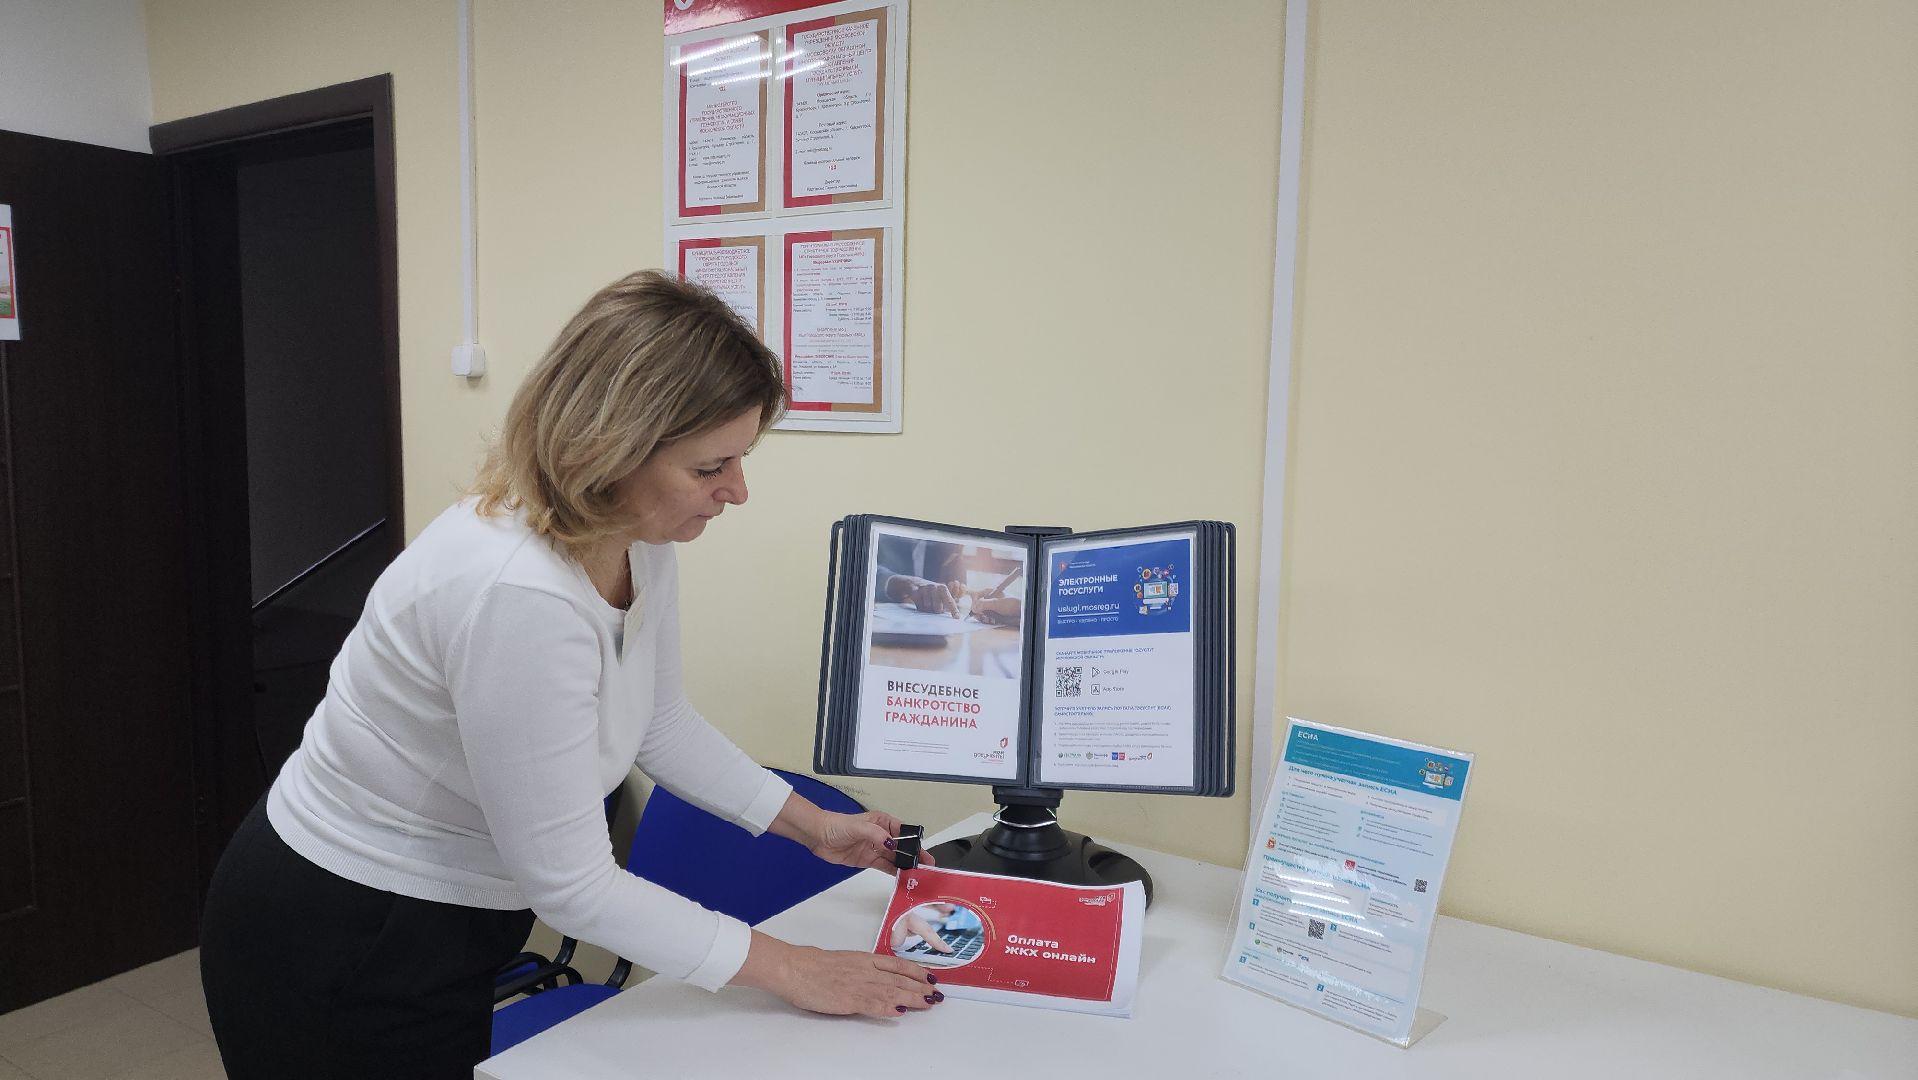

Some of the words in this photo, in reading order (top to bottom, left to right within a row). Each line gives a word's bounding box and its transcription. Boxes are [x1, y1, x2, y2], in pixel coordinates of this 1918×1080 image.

[1058, 574, 1118, 586] ЭЛЕКТРОННЫЕ
[1058, 586, 1104, 596] ГОСУСЛУГИ
[887, 680, 979, 699] ВНЕСУДЕБНОЕ
[886, 696, 981, 714] БАНКРОТСТВО
[885, 712, 978, 728] ГРАЖДАНИНА
[1297, 730, 1320, 742] ЕСИА
[1379, 786, 1397, 796] ЕСИА
[1007, 934, 1059, 949] Оплата
[1004, 946, 1039, 958] ЖКХ
[1042, 951, 1096, 964] онлайн
